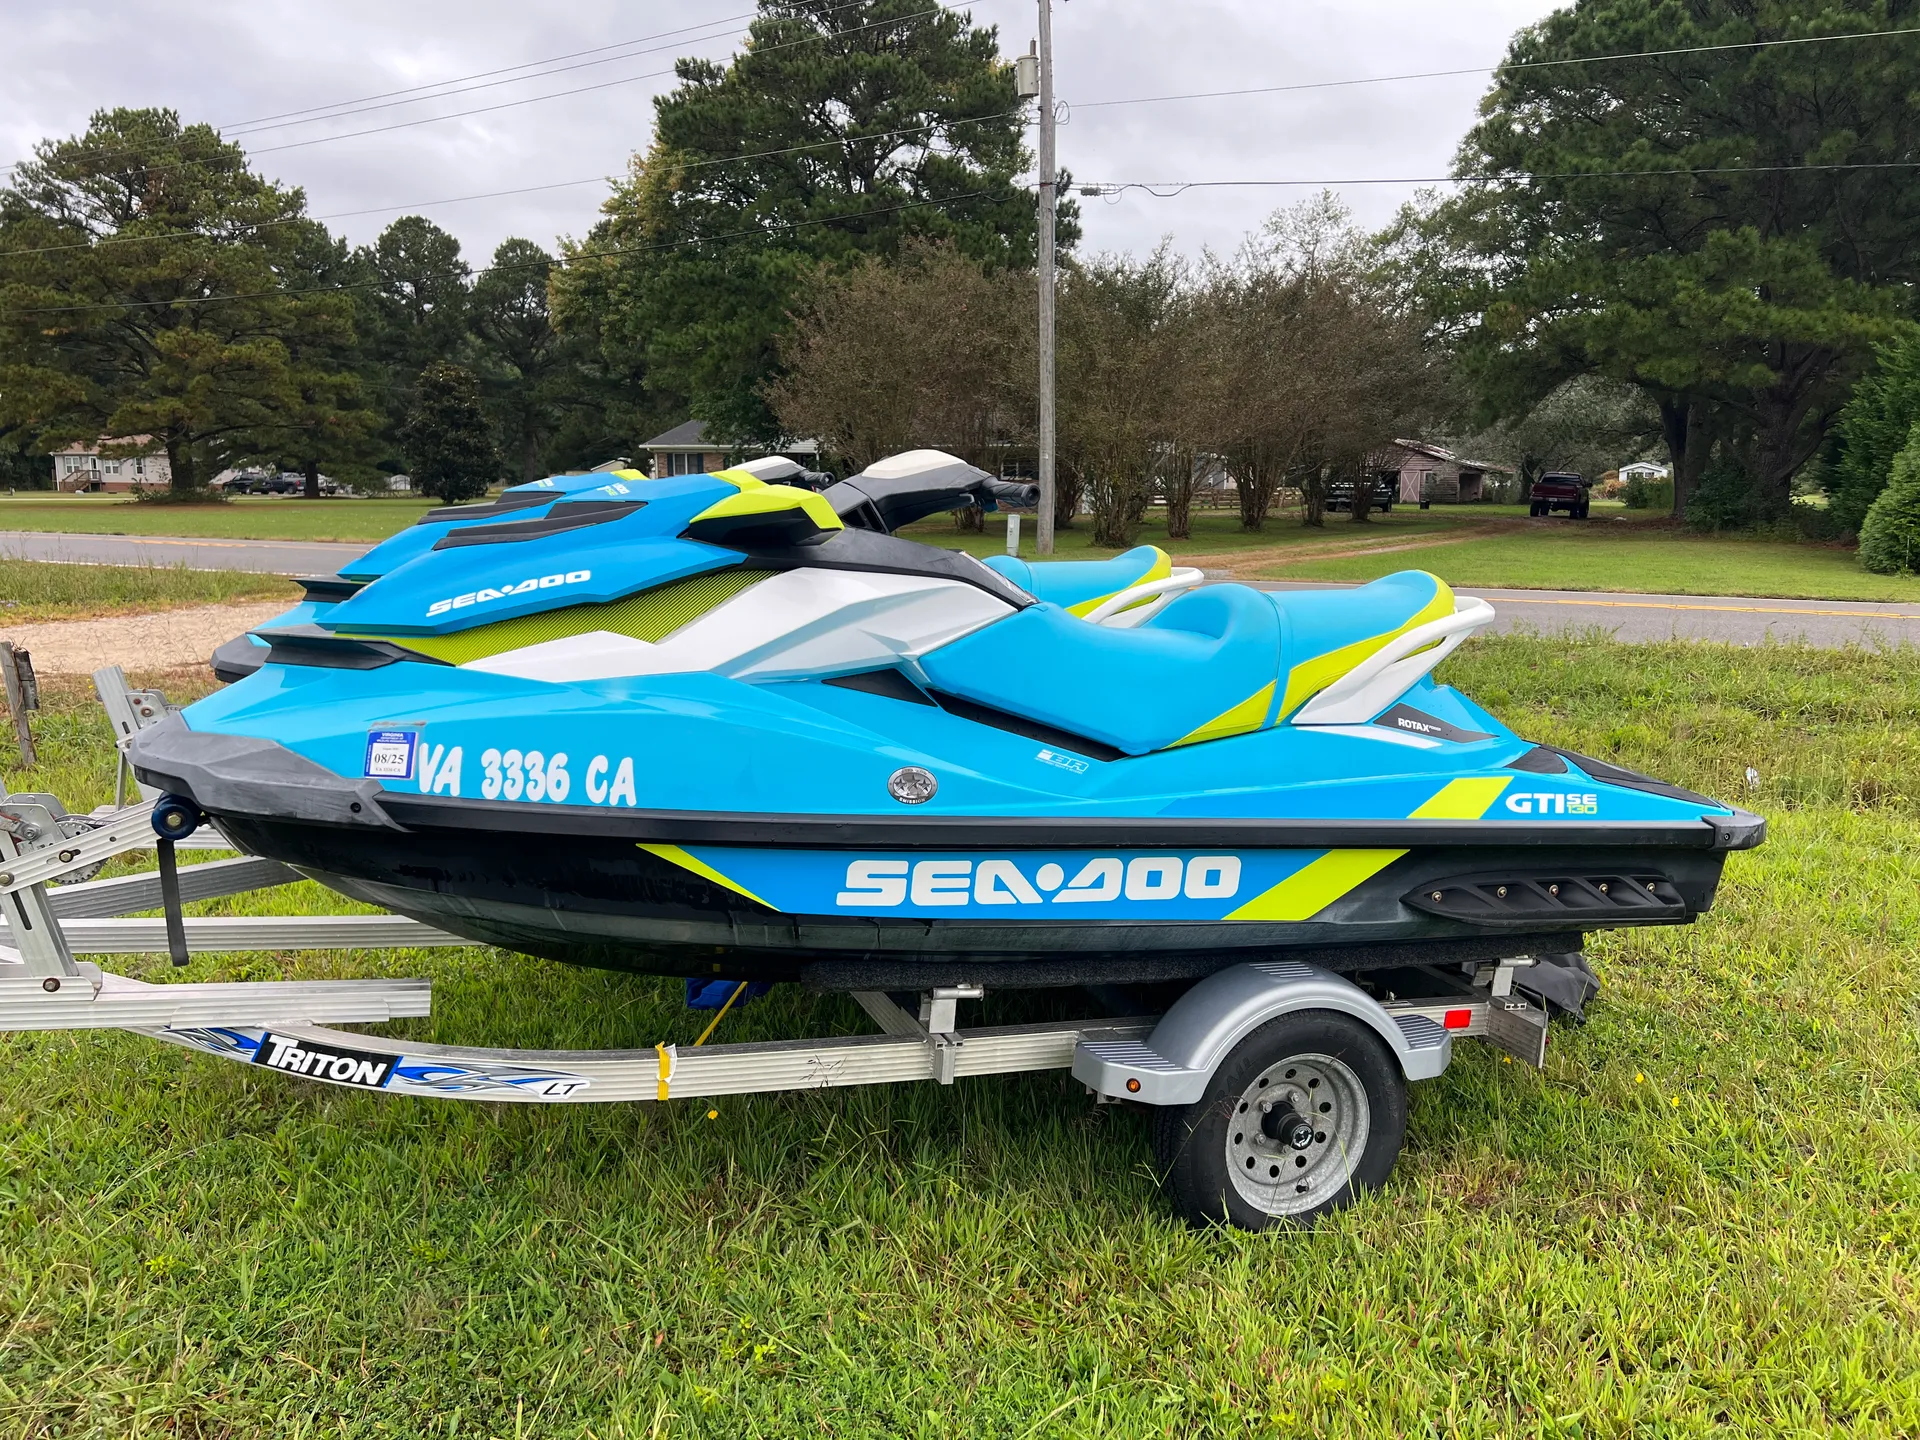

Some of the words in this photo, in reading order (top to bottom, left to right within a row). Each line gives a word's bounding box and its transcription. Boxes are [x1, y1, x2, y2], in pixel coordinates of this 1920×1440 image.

[1397, 717, 1430, 732] ROTAX
[374, 753, 404, 764] 08/25
[418, 742, 463, 797] VA
[480, 748, 570, 802] 3336
[585, 755, 637, 806] CA
[1505, 793, 1565, 814] GTI
[1566, 793, 1597, 804] SE
[1567, 804, 1597, 814] 130
[267, 1034, 387, 1085] TRITON
[542, 1082, 581, 1096] LT
